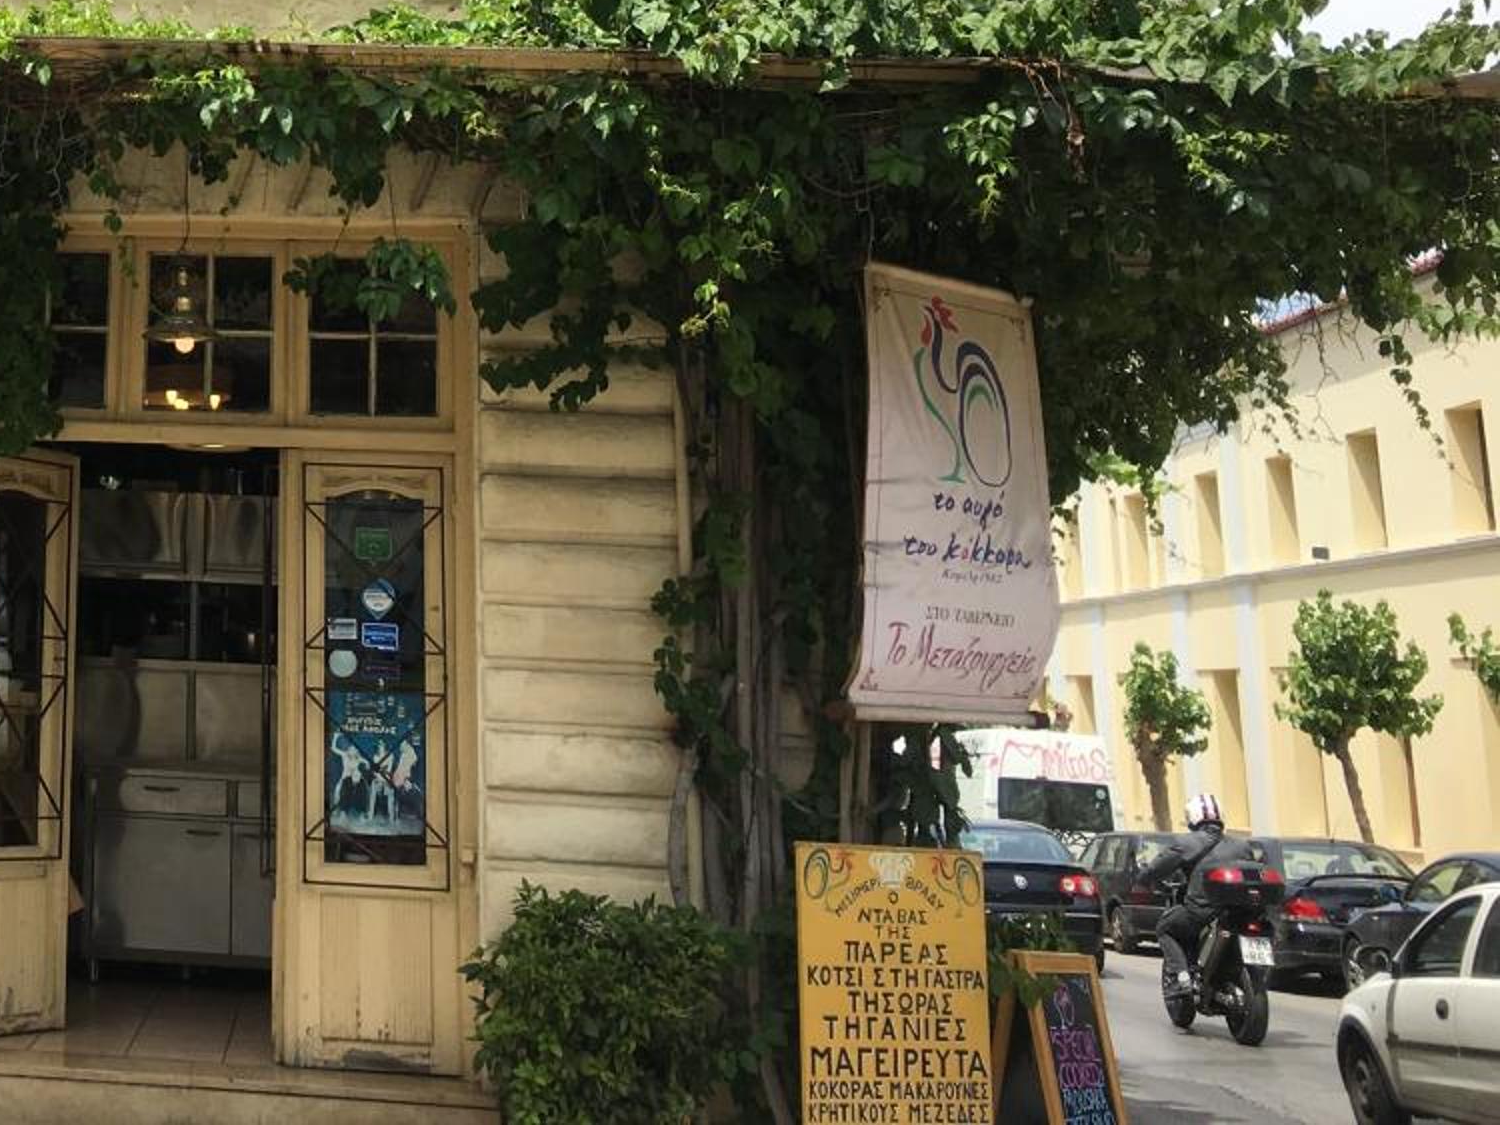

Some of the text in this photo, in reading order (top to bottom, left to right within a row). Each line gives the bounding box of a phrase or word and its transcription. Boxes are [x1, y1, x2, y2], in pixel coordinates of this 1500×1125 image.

[857, 908, 928, 925] ΝΤΑΒΑΣ
[874, 925, 911, 939] ΤΗΣ
[844, 941, 948, 965] ΠΑΡΕΑΣ
[807, 965, 985, 990] ΚΟΤΣΙ ΣΤΗ ΓΑΣΤΡΑ
[848, 991, 953, 1016] ΤΗΣ ΩΡΑΣ
[823, 1015, 966, 1041] ΤΗΓΑΝΙΕΣ
[811, 1046, 988, 1078] ΜΑΓΕΙΡΕΥΤΑ
[809, 1081, 990, 1100] ΚΟΚΟΡΑΣ ΜΑΚΑΡΟΥΝΕΣ
[809, 1102, 990, 1124] ΚΡΗΤΙΚΟΥΣ ΜΕΖΕΔΕΣ
